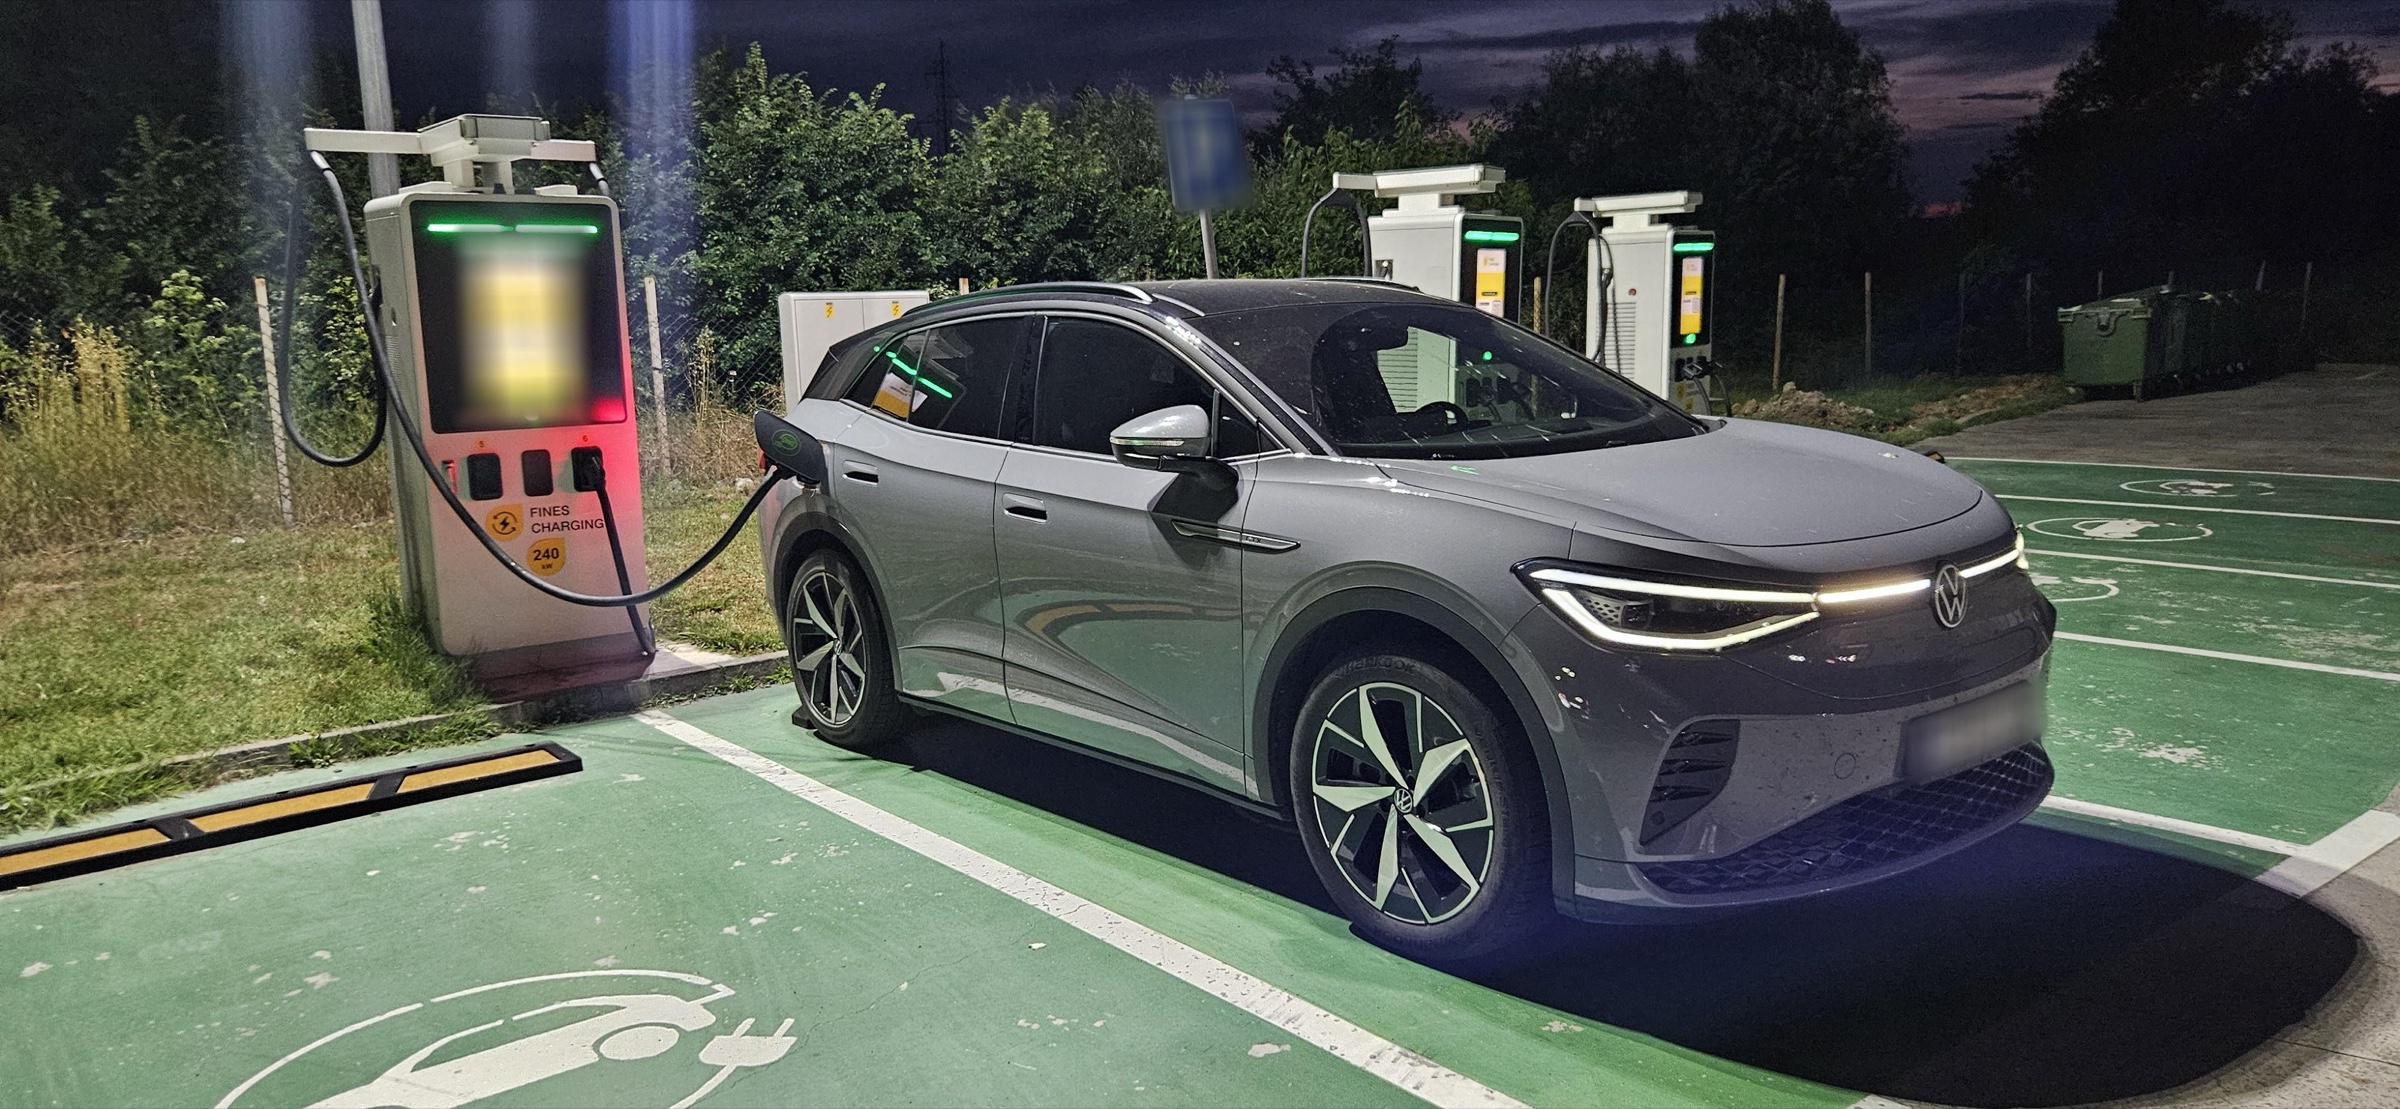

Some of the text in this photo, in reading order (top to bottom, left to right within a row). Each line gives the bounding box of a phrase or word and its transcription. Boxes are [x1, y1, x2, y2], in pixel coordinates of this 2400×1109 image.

[530, 505, 570, 517] FINES
[531, 518, 604, 533] CHARGING
[533, 548, 560, 561] 240
[1936, 565, 1966, 627] VW
